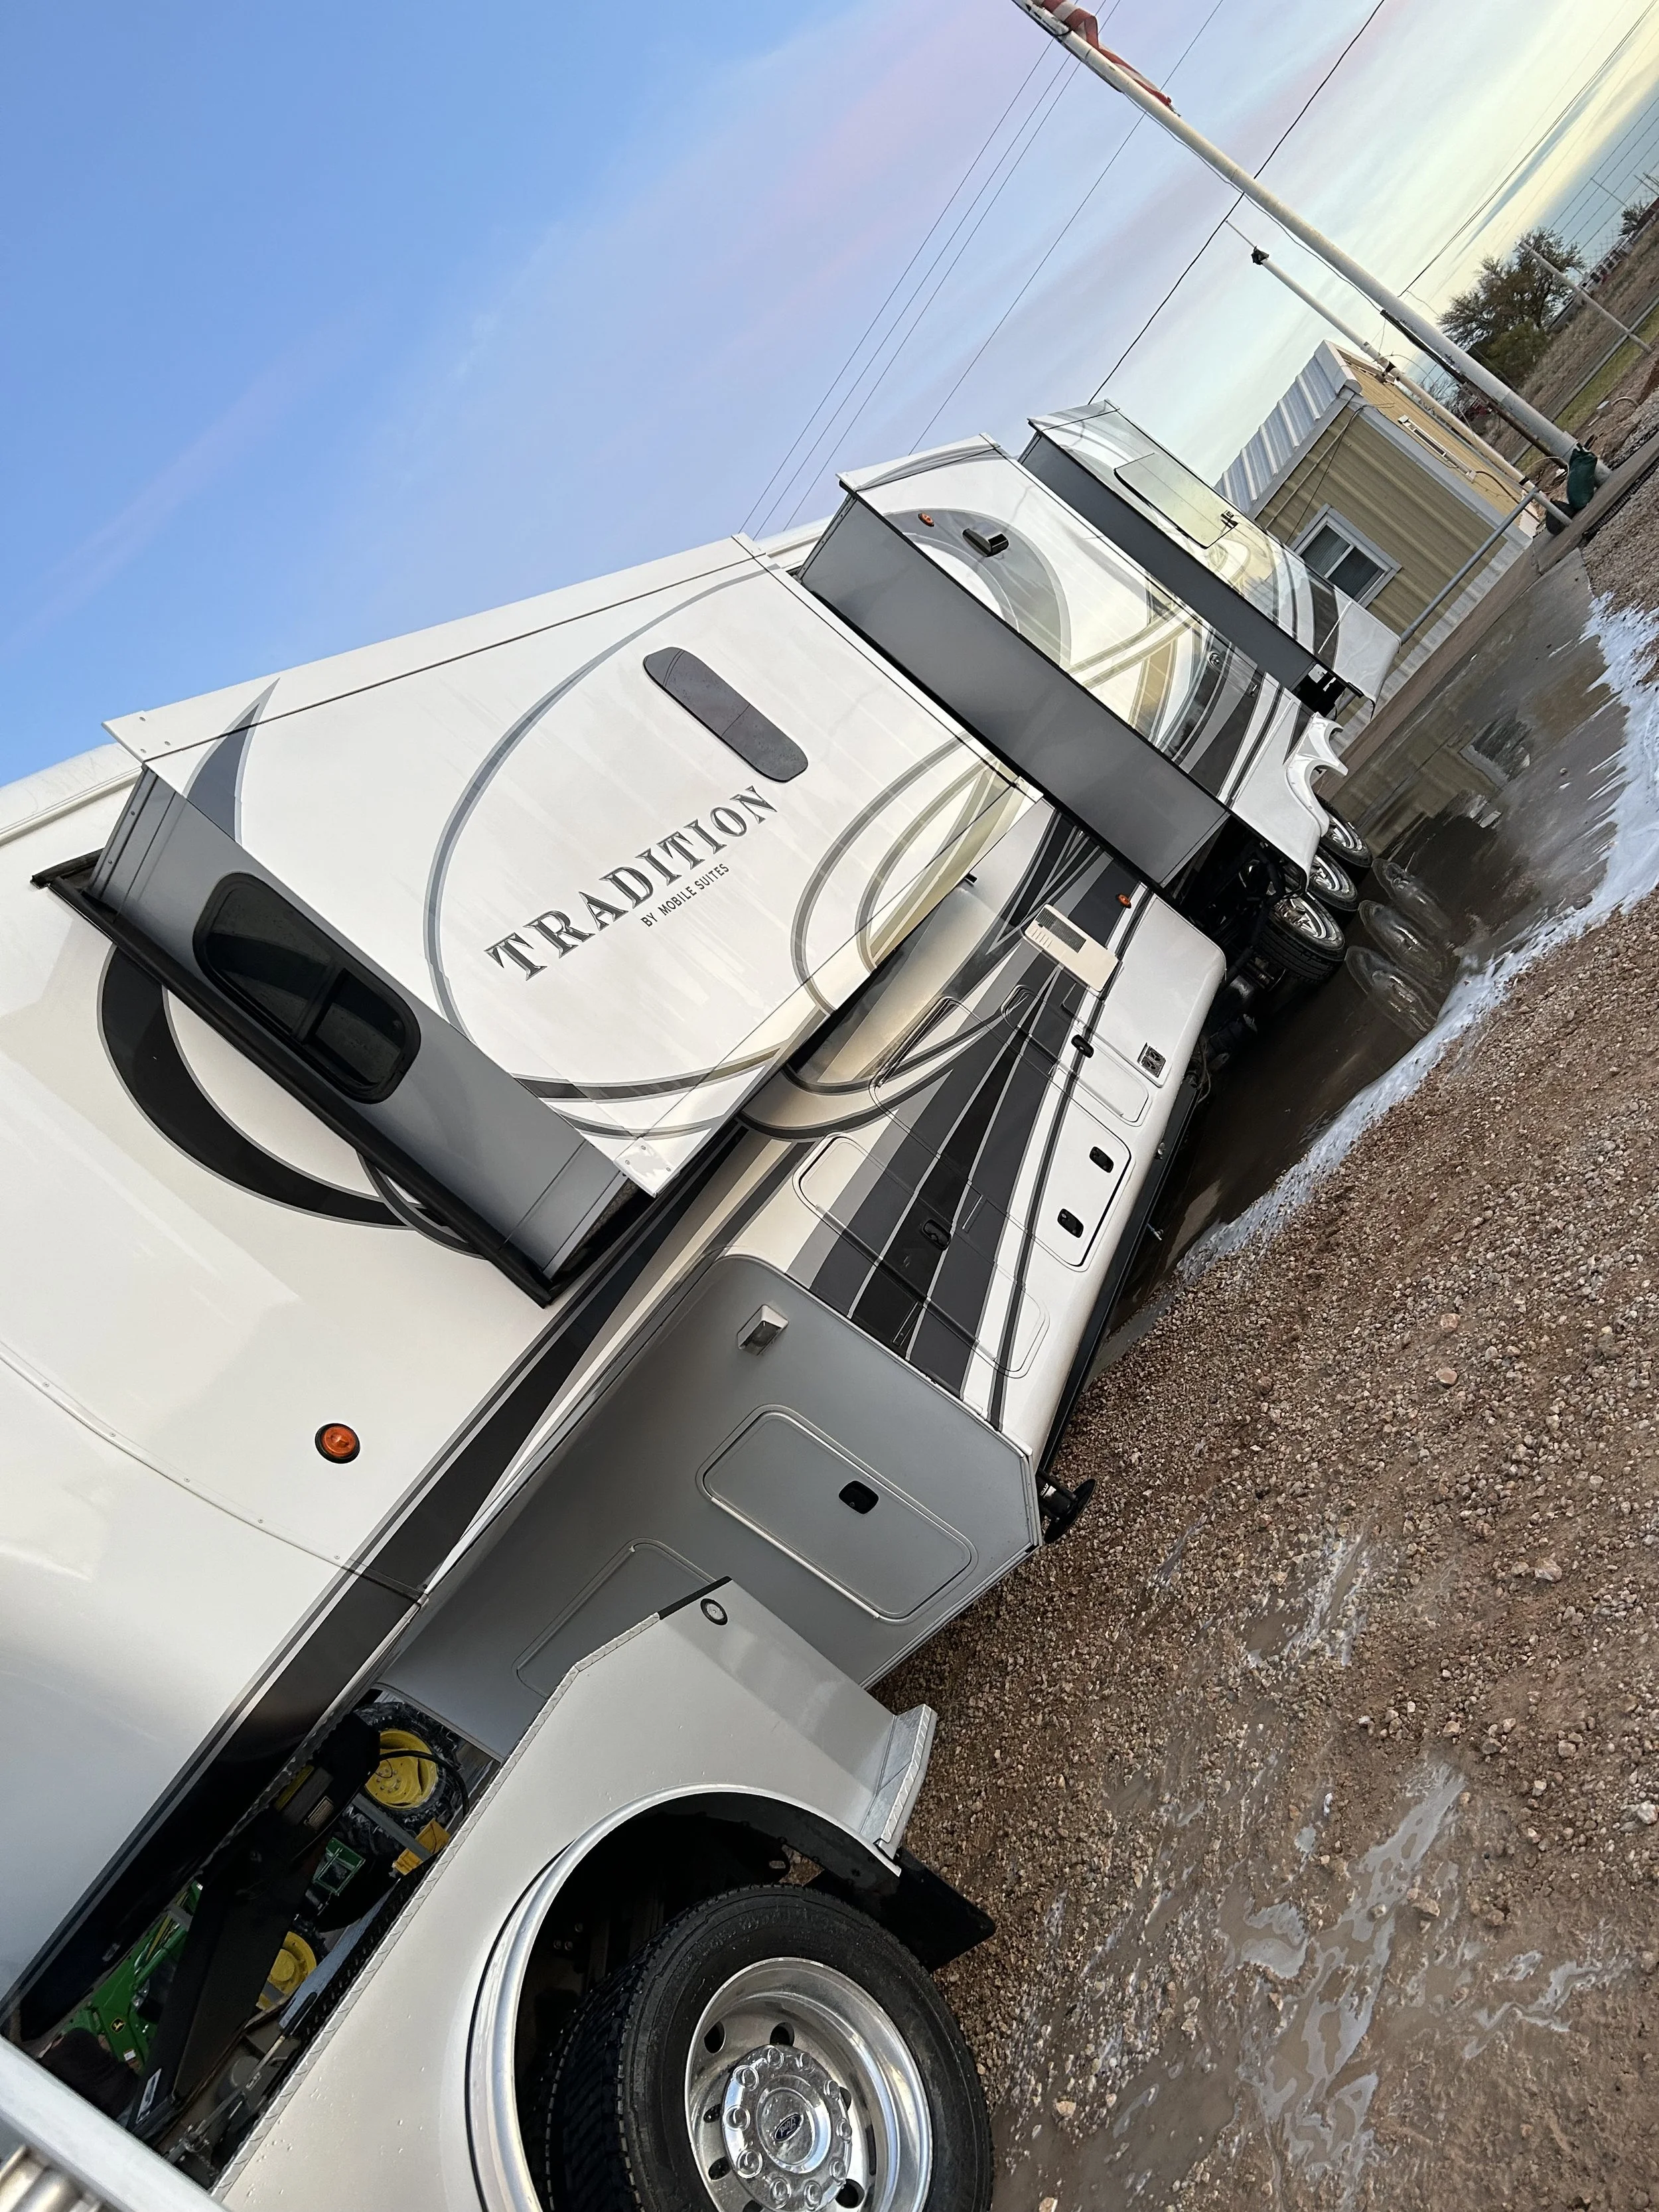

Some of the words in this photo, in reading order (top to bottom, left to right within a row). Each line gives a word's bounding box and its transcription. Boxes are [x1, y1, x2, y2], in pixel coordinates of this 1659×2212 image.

[484, 785, 778, 981] TRADITION
[640, 913, 658, 927] BY
[658, 886, 697, 916] MOBILE
[694, 863, 729, 890] SUITES
[778, 2116, 798, 2138] Ford
